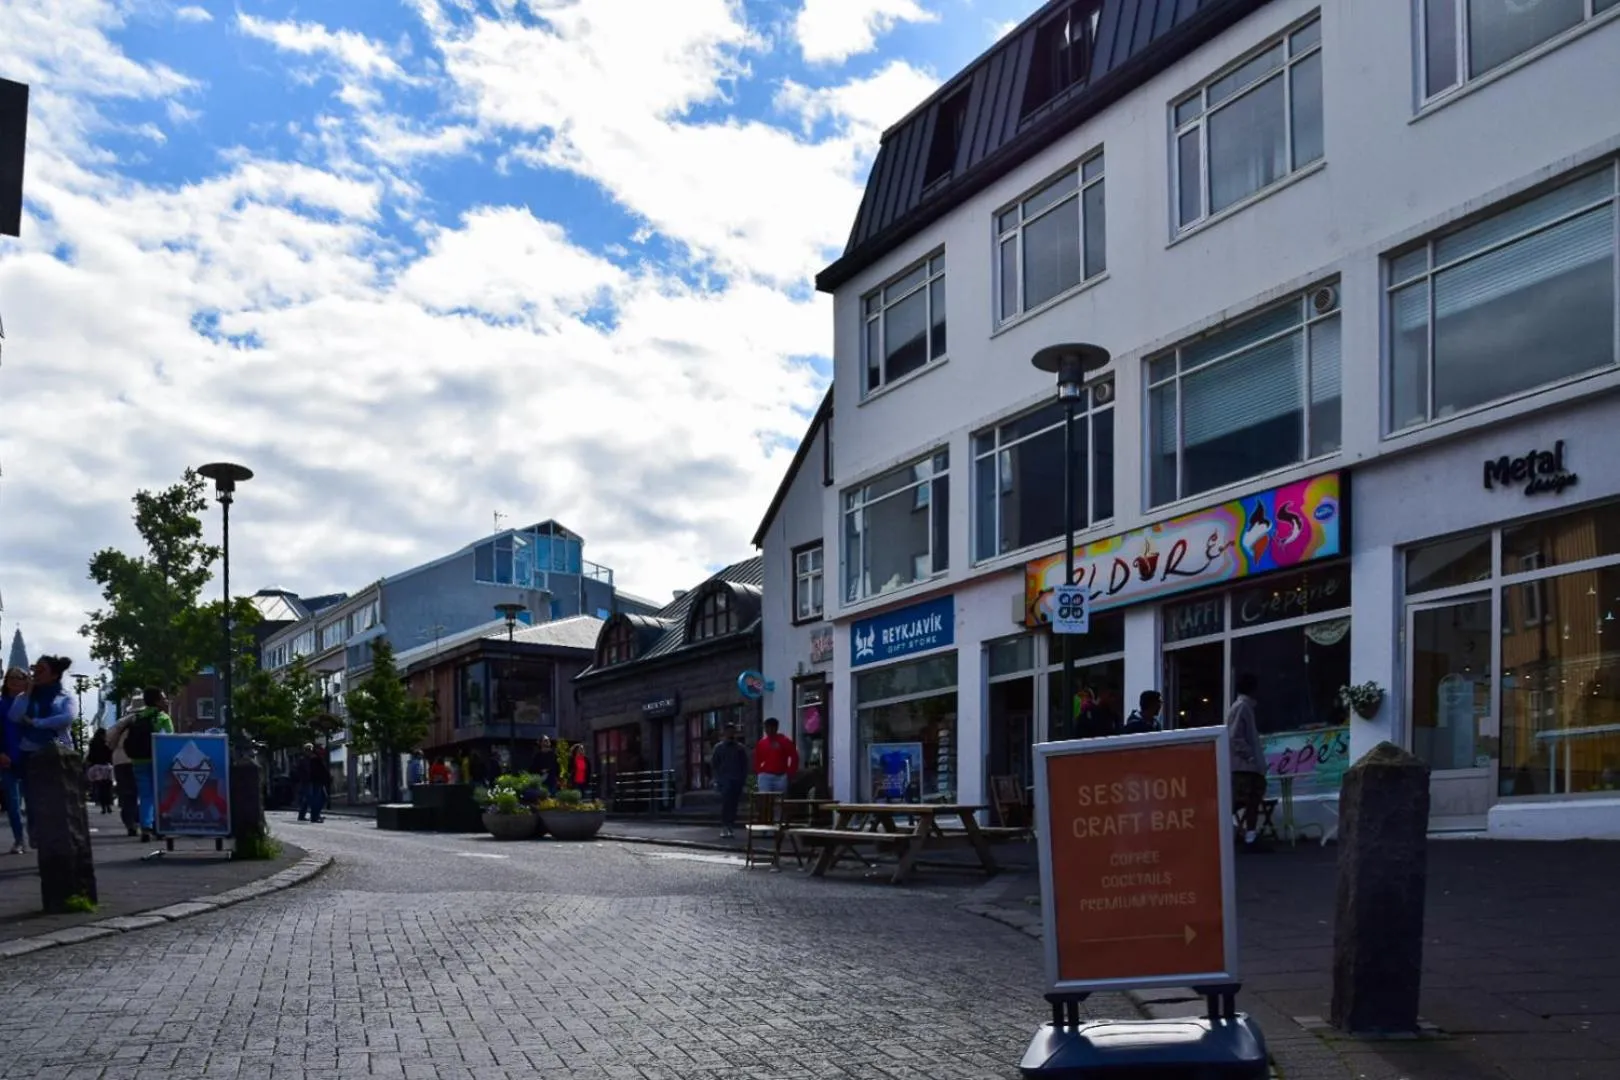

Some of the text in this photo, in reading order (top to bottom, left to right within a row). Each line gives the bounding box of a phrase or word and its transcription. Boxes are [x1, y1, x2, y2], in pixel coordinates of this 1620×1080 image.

[1484, 439, 1564, 490] Metal
[881, 611, 943, 645] REYKJAVÍK
[907, 635, 937, 649] STORE
[1078, 775, 1188, 807] SESSION
[1072, 807, 1196, 839] CRAFT BAR
[1110, 850, 1160, 867] COFFEE
[1101, 871, 1173, 889] COCKTAILS
[1079, 893, 1147, 912] PREMIUM
